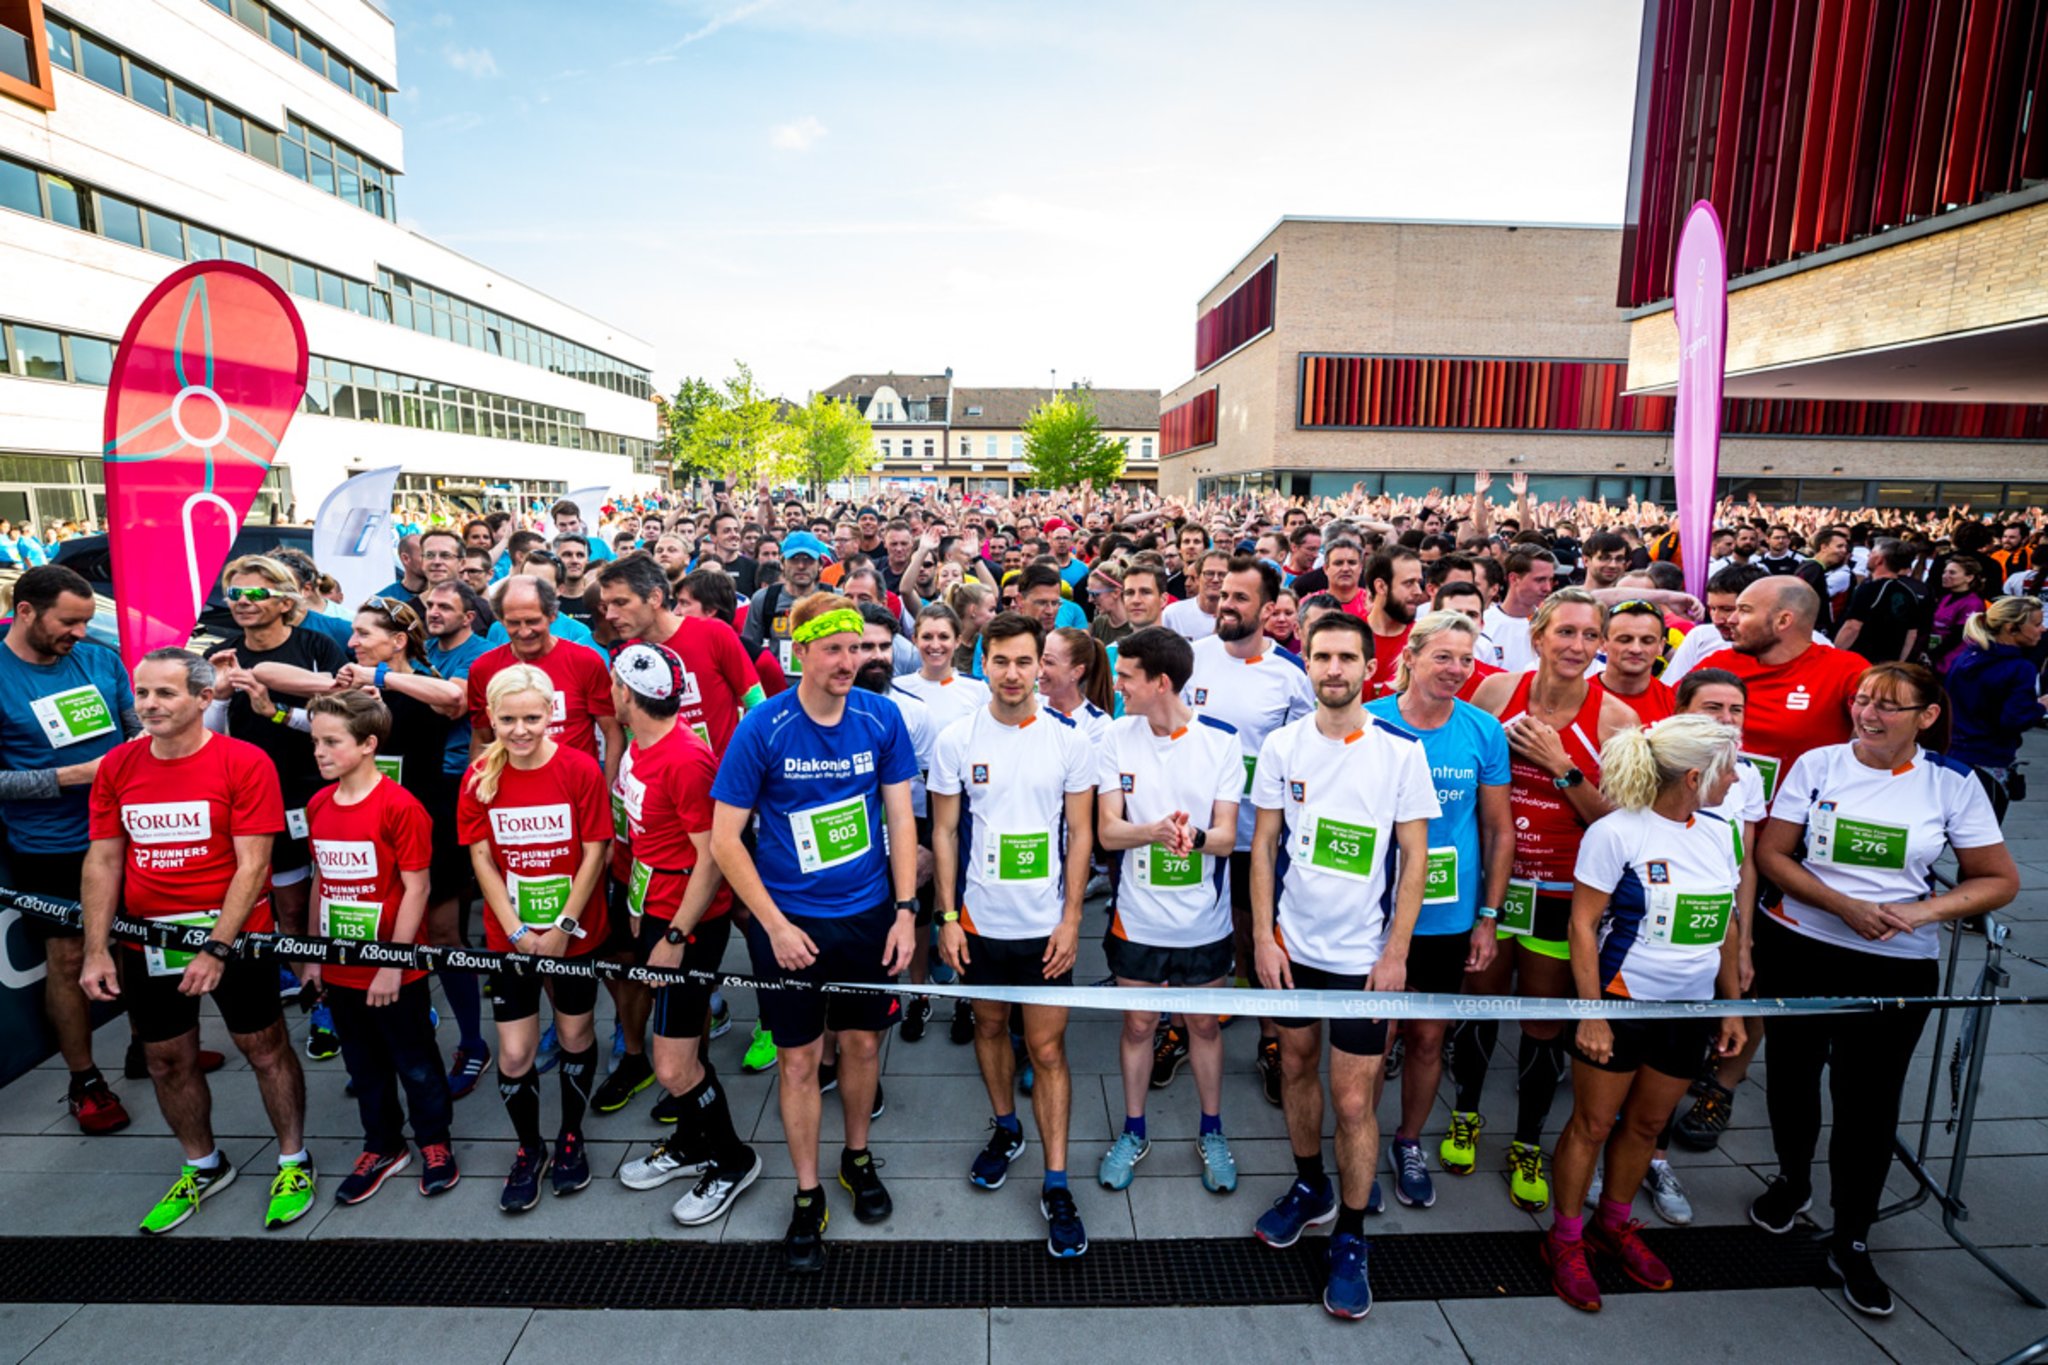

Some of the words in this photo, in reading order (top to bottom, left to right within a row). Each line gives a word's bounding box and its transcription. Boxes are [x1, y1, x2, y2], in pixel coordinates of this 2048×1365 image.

[784, 757, 851, 772] Diakonie
[1433, 764, 1474, 779] ntrum
[1438, 788, 1464, 804] ger
[828, 823, 858, 844] 803
[1516, 833, 1541, 841] RICH
[151, 846, 208, 859] RUNNERS
[521, 847, 569, 859] RUNNERS
[1328, 839, 1360, 857] 453
[1850, 838, 1888, 855] 276
[151, 859, 185, 869] POINT
[521, 859, 551, 869] POINT
[1016, 850, 1035, 865] 59
[1163, 859, 1190, 872] 376
[1429, 870, 1448, 884] 63
[13, 895, 68, 922] innogy
[529, 896, 559, 911] 1151
[1504, 900, 1524, 915] 05
[111, 917, 148, 940] inno
[1689, 914, 1719, 928] 275
[336, 923, 365, 938] 1135
[274, 938, 327, 960] innogy
[360, 944, 413, 966] innogy
[447, 951, 502, 973] innogy
[536, 959, 592, 977] innogy
